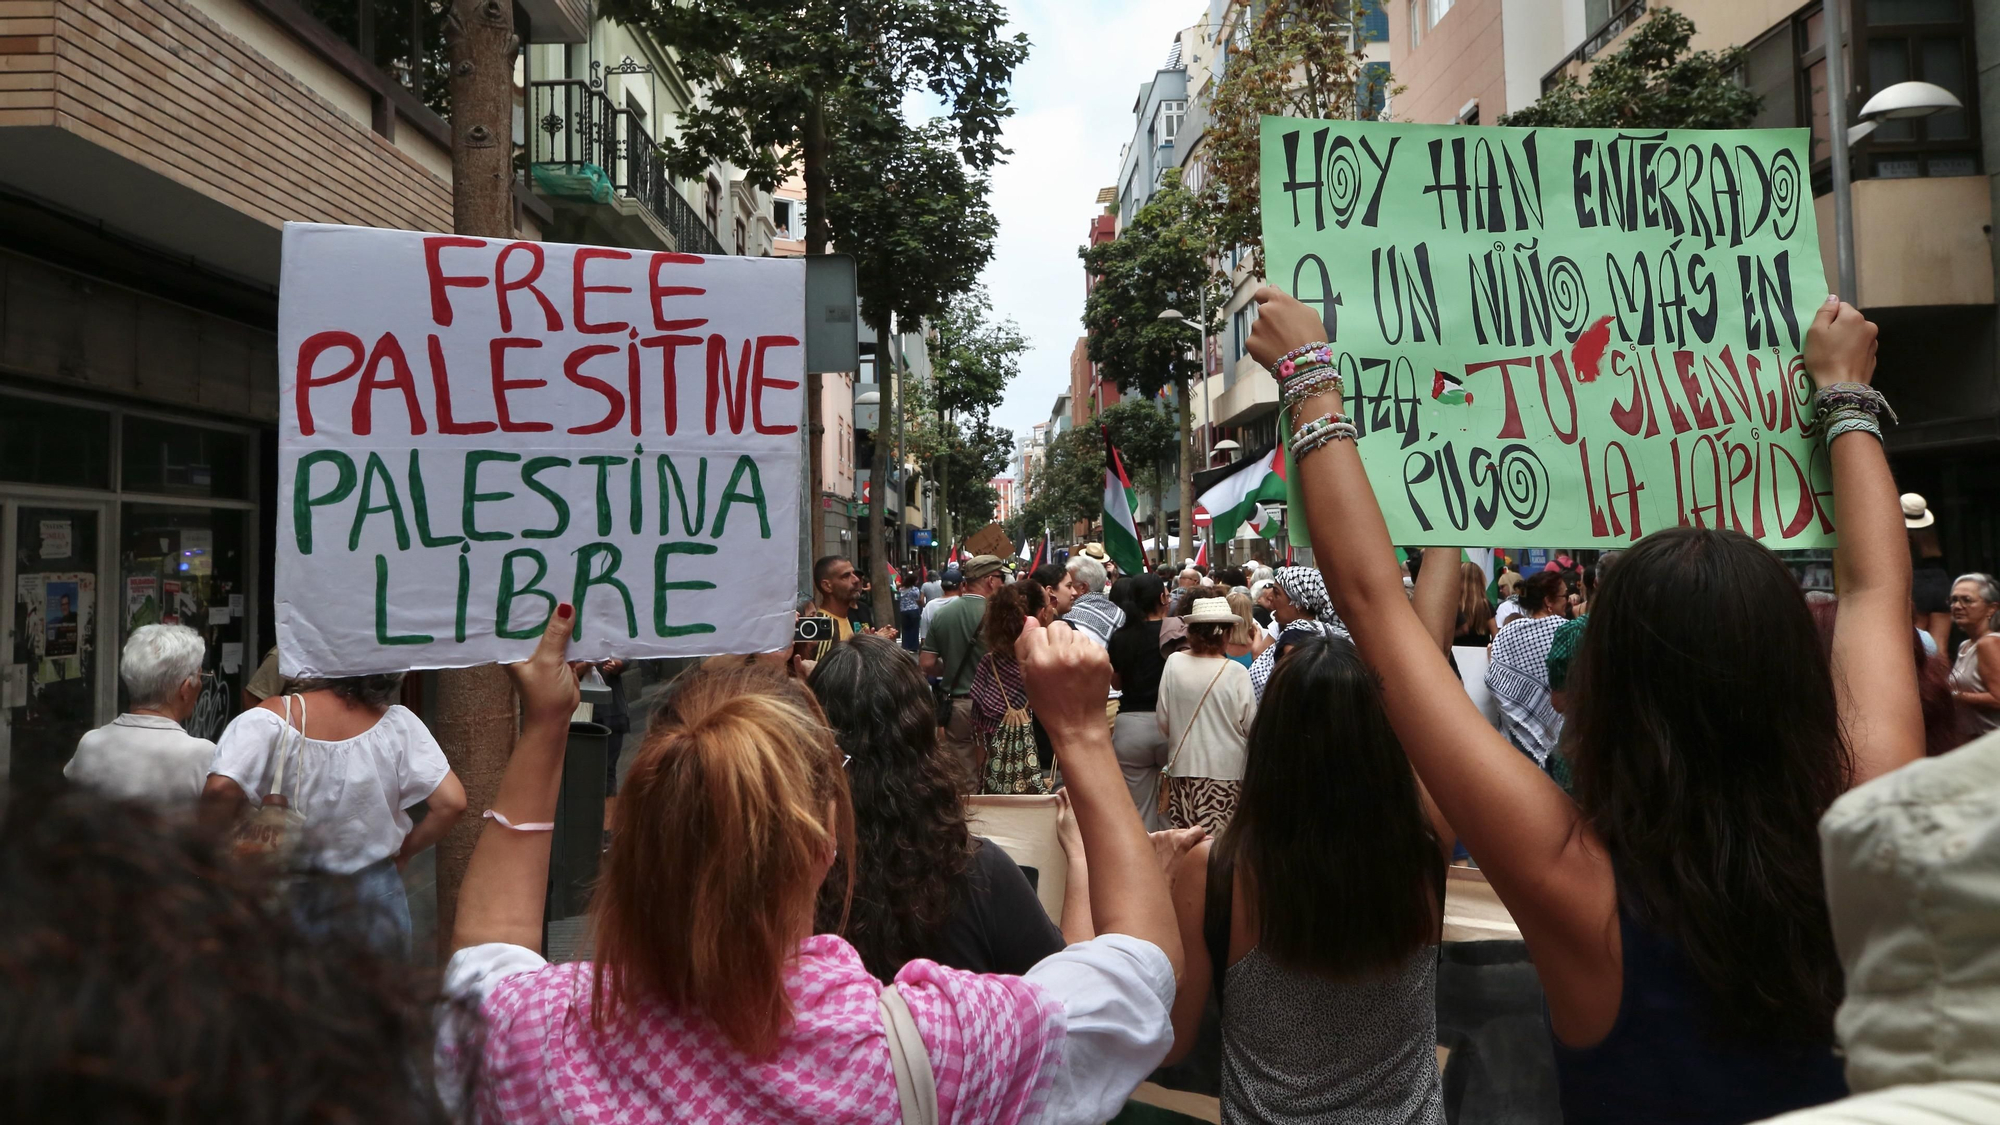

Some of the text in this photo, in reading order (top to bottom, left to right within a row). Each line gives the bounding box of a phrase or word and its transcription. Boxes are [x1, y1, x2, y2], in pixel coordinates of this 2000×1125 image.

[1282, 127, 1801, 250] HOY HAN ENTERRADO
[424, 237, 709, 335] FREE
[1293, 237, 1801, 352] A UN NIÑO MÁS EN
[1337, 344, 1817, 450] AZA TU SILENCIO
[293, 443, 771, 555] PALESTINA
[1579, 436, 1645, 542] LA
[375, 541, 718, 645] LIBRE
